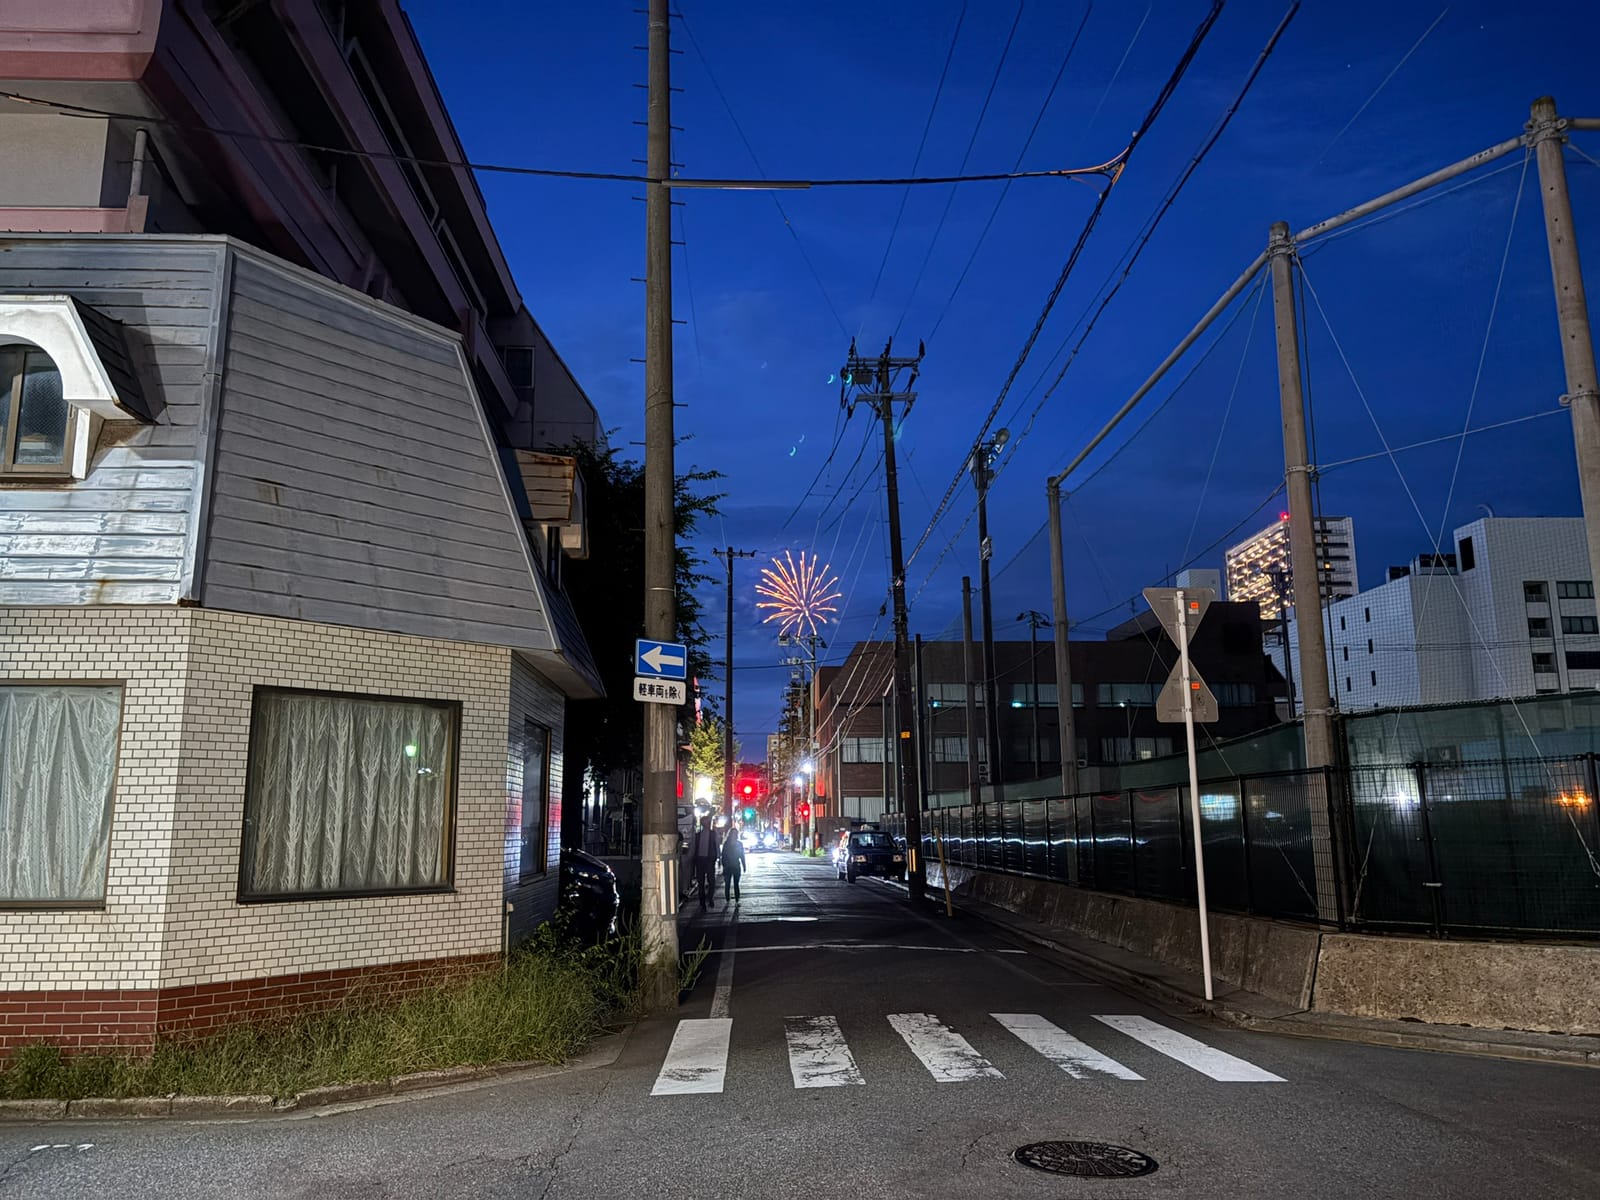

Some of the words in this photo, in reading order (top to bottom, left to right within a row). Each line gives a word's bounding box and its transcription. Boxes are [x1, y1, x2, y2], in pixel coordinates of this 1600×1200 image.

[639, 683, 681, 700] 軽車両を除く
